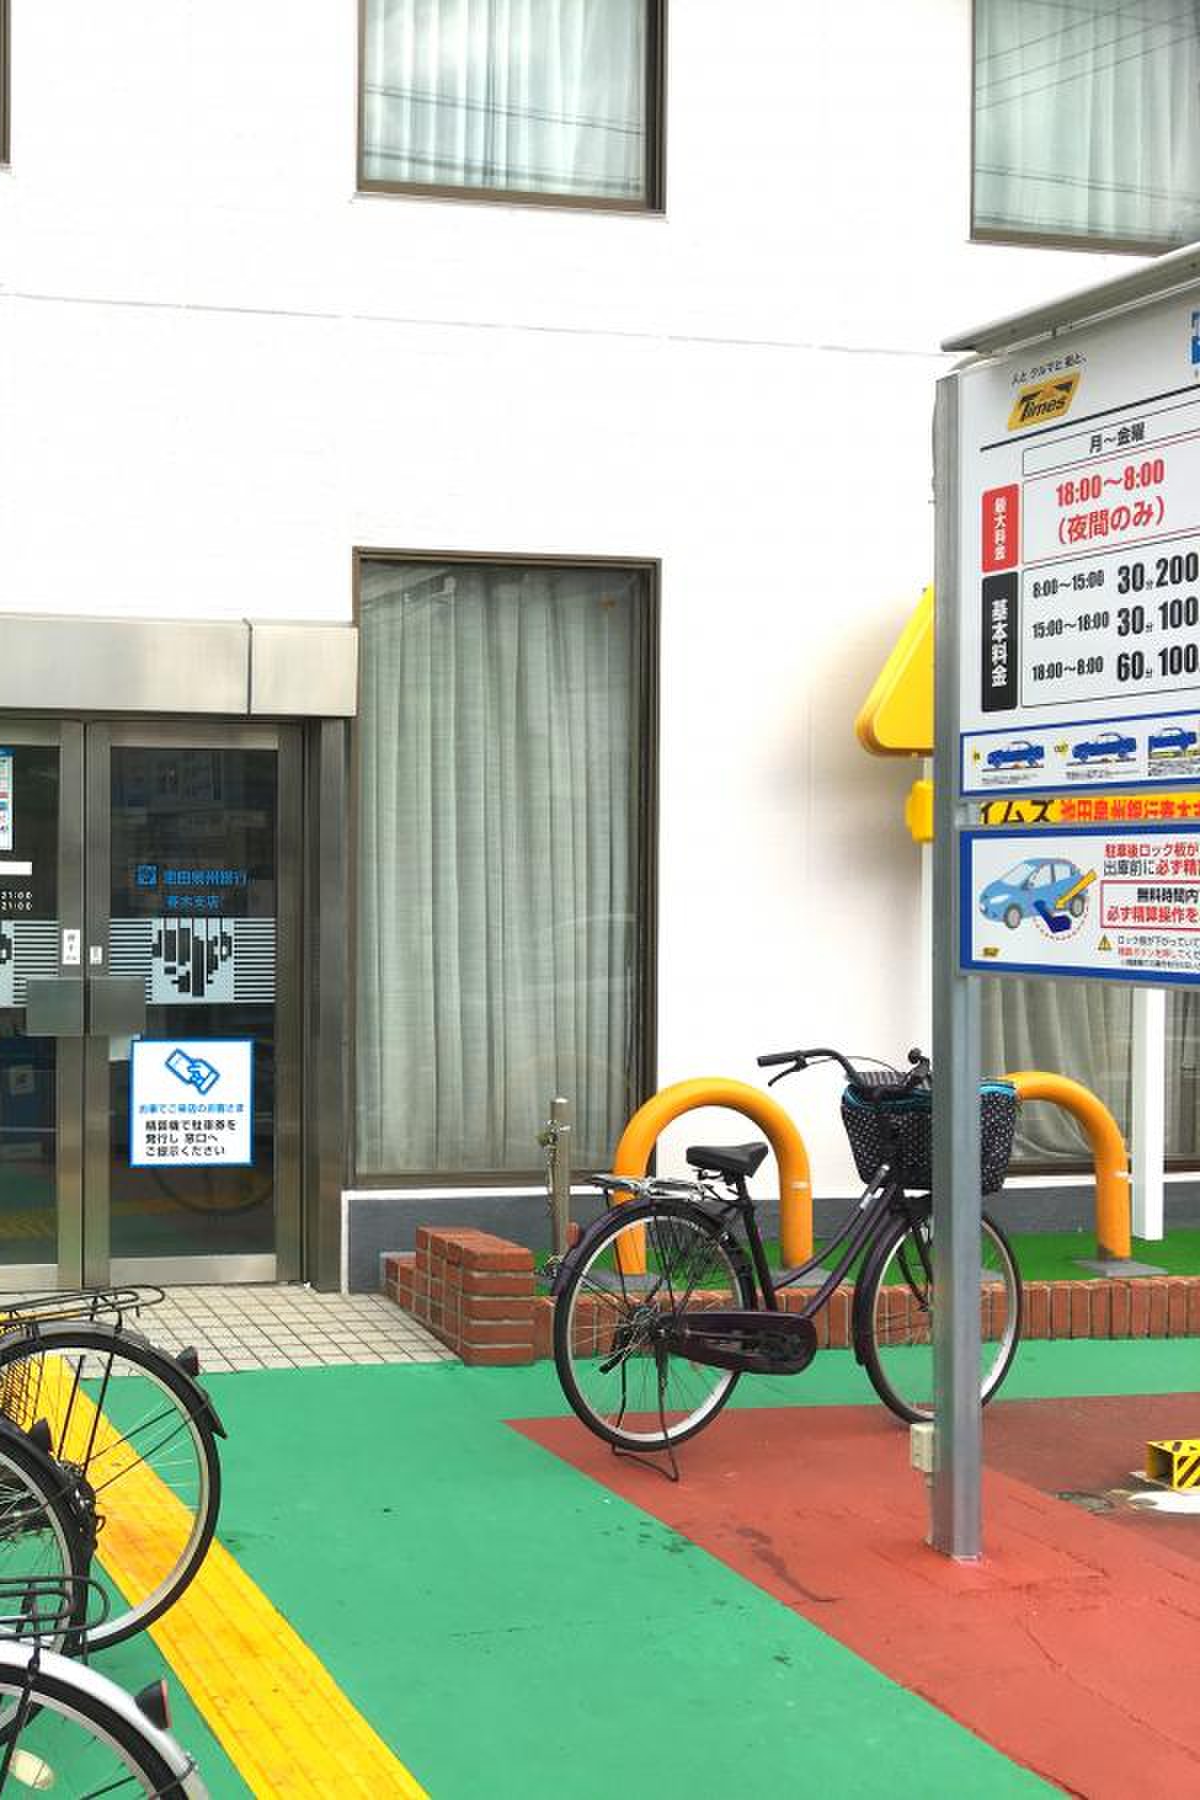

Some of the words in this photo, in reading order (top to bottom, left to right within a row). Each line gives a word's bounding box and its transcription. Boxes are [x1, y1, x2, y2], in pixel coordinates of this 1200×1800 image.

[1019, 382, 1073, 422] Times
[991, 598, 1009, 688] 基本料金
[1104, 858, 1200, 877] 出庫前に必ず精
